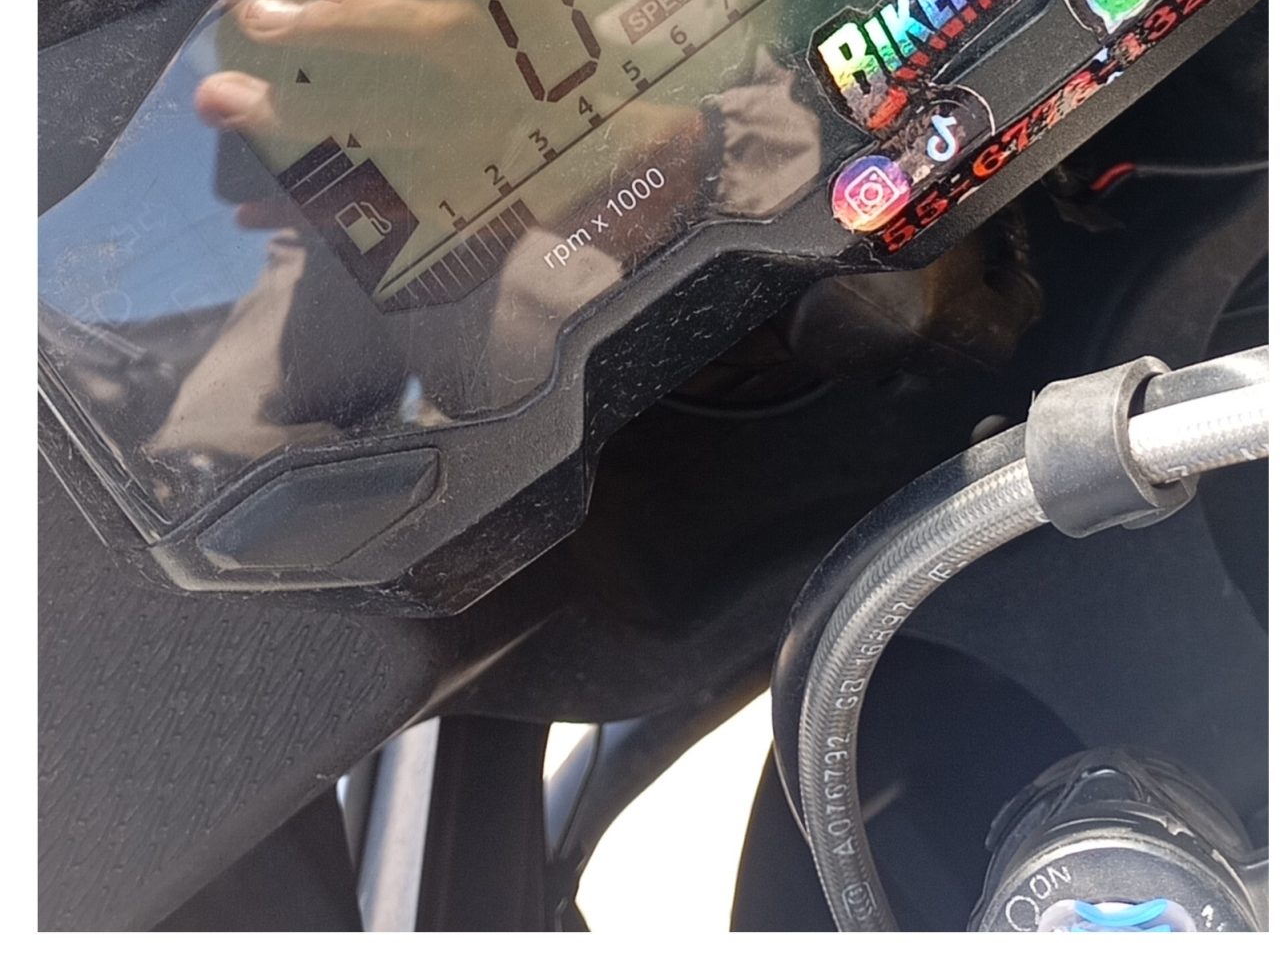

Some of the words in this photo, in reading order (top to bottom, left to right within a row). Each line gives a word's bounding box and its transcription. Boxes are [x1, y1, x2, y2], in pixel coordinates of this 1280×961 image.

[438, 199, 457, 218] 1
[484, 163, 505, 185] 2
[528, 128, 548, 152] 3
[577, 95, 594, 116] 4
[621, 60, 641, 81] 5
[669, 24, 688, 46] 6
[543, 227, 592, 270] rpm
[606, 167, 666, 217] 1000
[1028, 865, 1072, 900] ON
